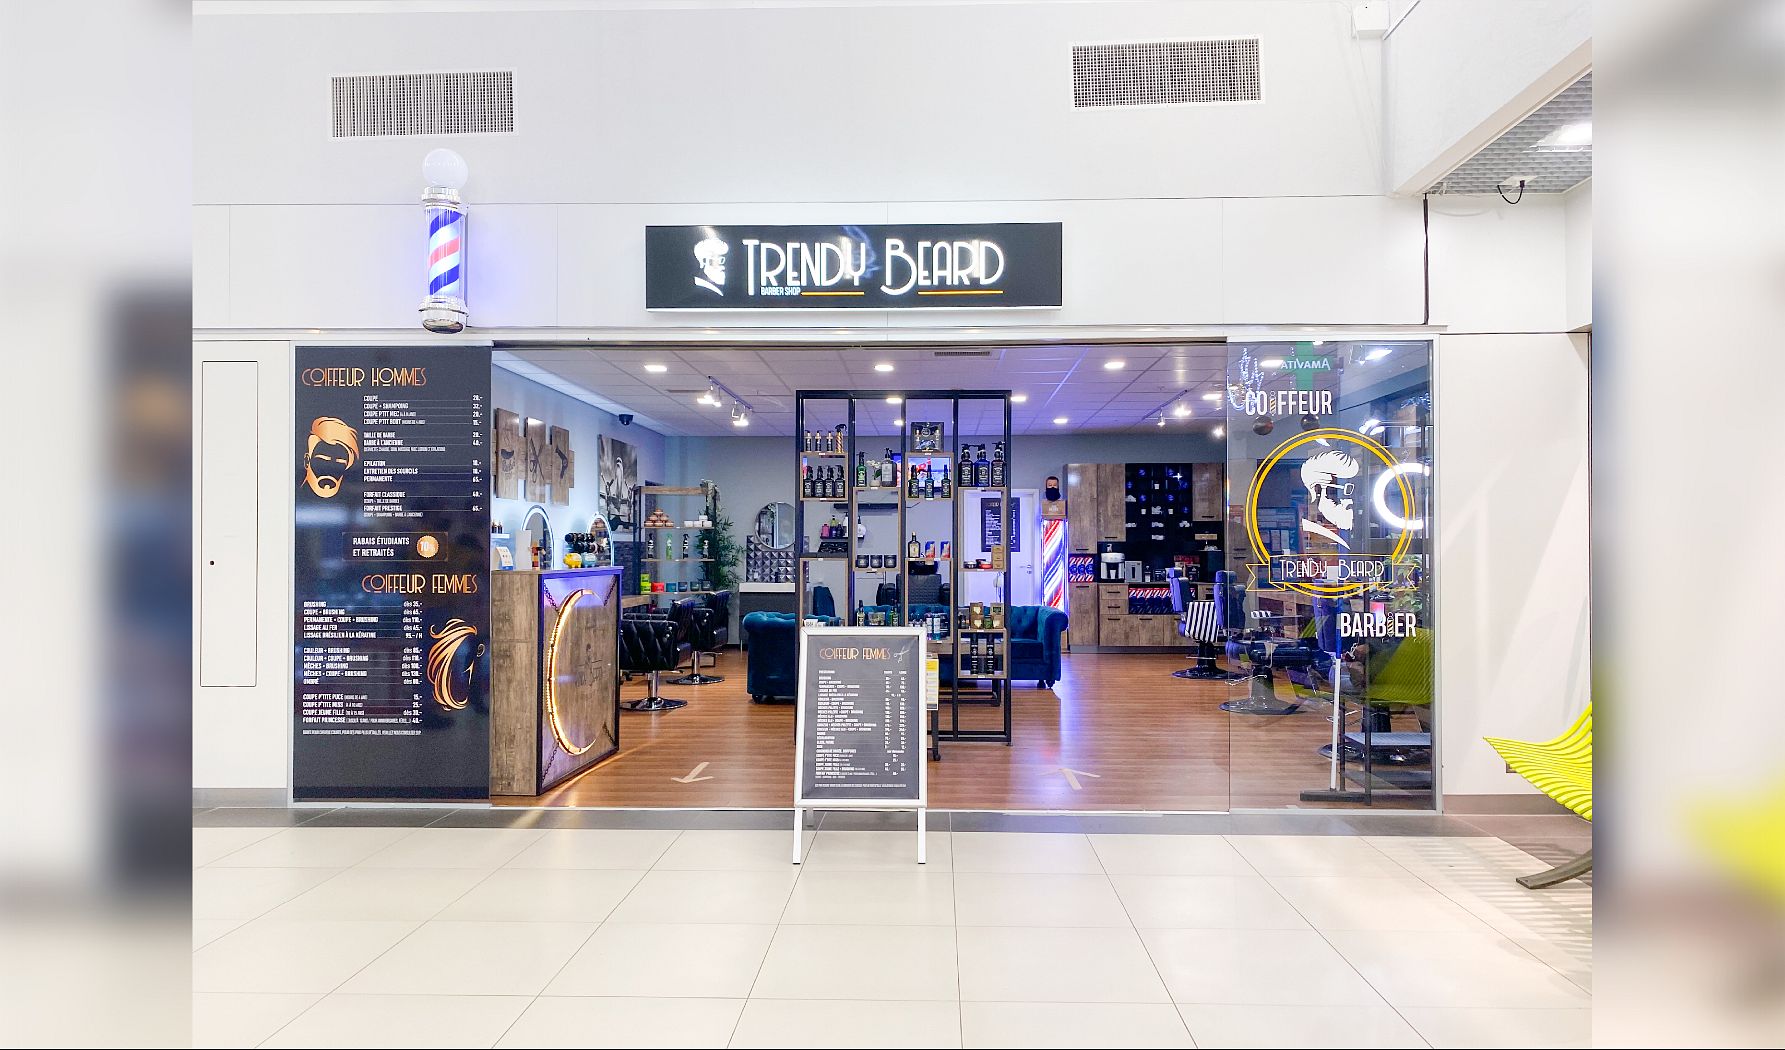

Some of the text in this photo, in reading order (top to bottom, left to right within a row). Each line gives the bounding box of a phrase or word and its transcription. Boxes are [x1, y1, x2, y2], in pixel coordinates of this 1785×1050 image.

[742, 238, 1005, 296] TRENDY BEARD
[760, 286, 801, 296] BARBER SHOP
[302, 368, 427, 387] COIFFEUR HOMMES
[1245, 390, 1332, 416] COIFFEUR
[376, 536, 410, 545] ÉTUDIANTS
[362, 548, 394, 557] RETRAITÉS
[1280, 559, 1384, 580] TRENDY BEARD
[362, 574, 478, 594] COIFFEUR FEMMES
[1340, 612, 1416, 638] BARBIER
[820, 648, 891, 659] COIFFEUR FEMMES
